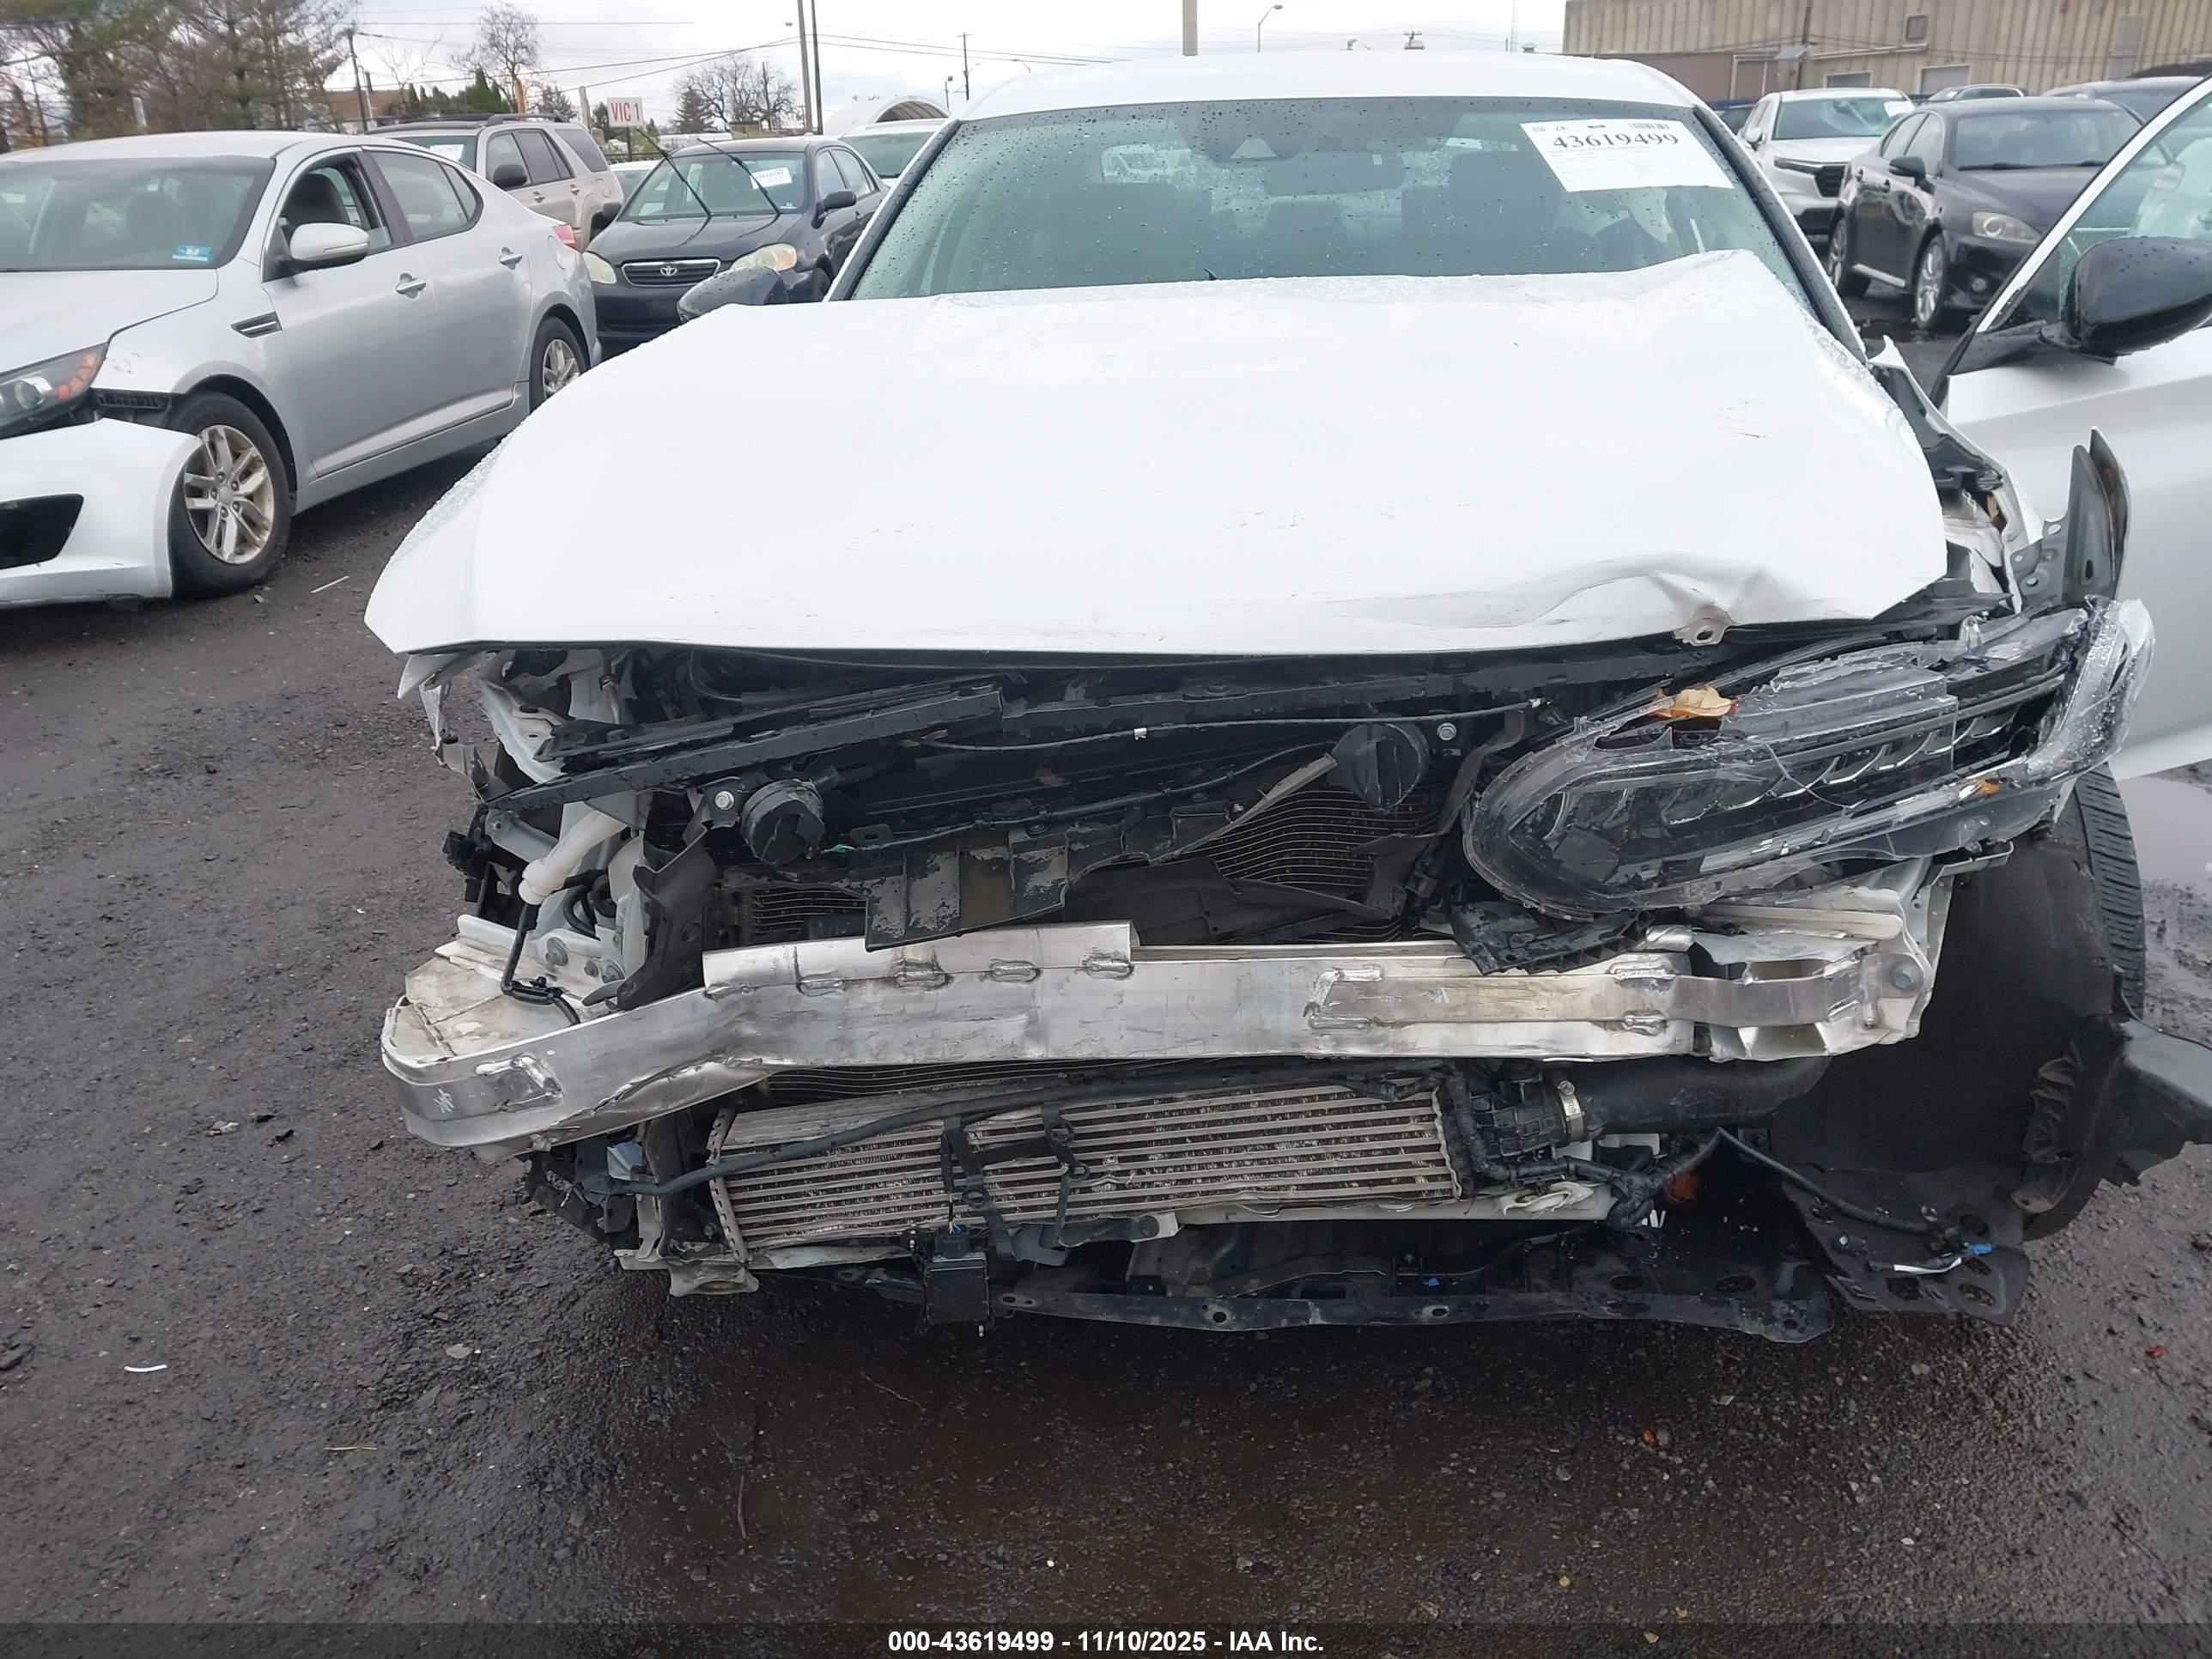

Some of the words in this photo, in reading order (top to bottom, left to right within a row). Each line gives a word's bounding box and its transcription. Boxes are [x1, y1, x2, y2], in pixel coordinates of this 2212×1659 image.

[611, 103, 631, 122] VIC
[635, 104, 640, 122] 1
[1553, 133, 1679, 149] 43619499
